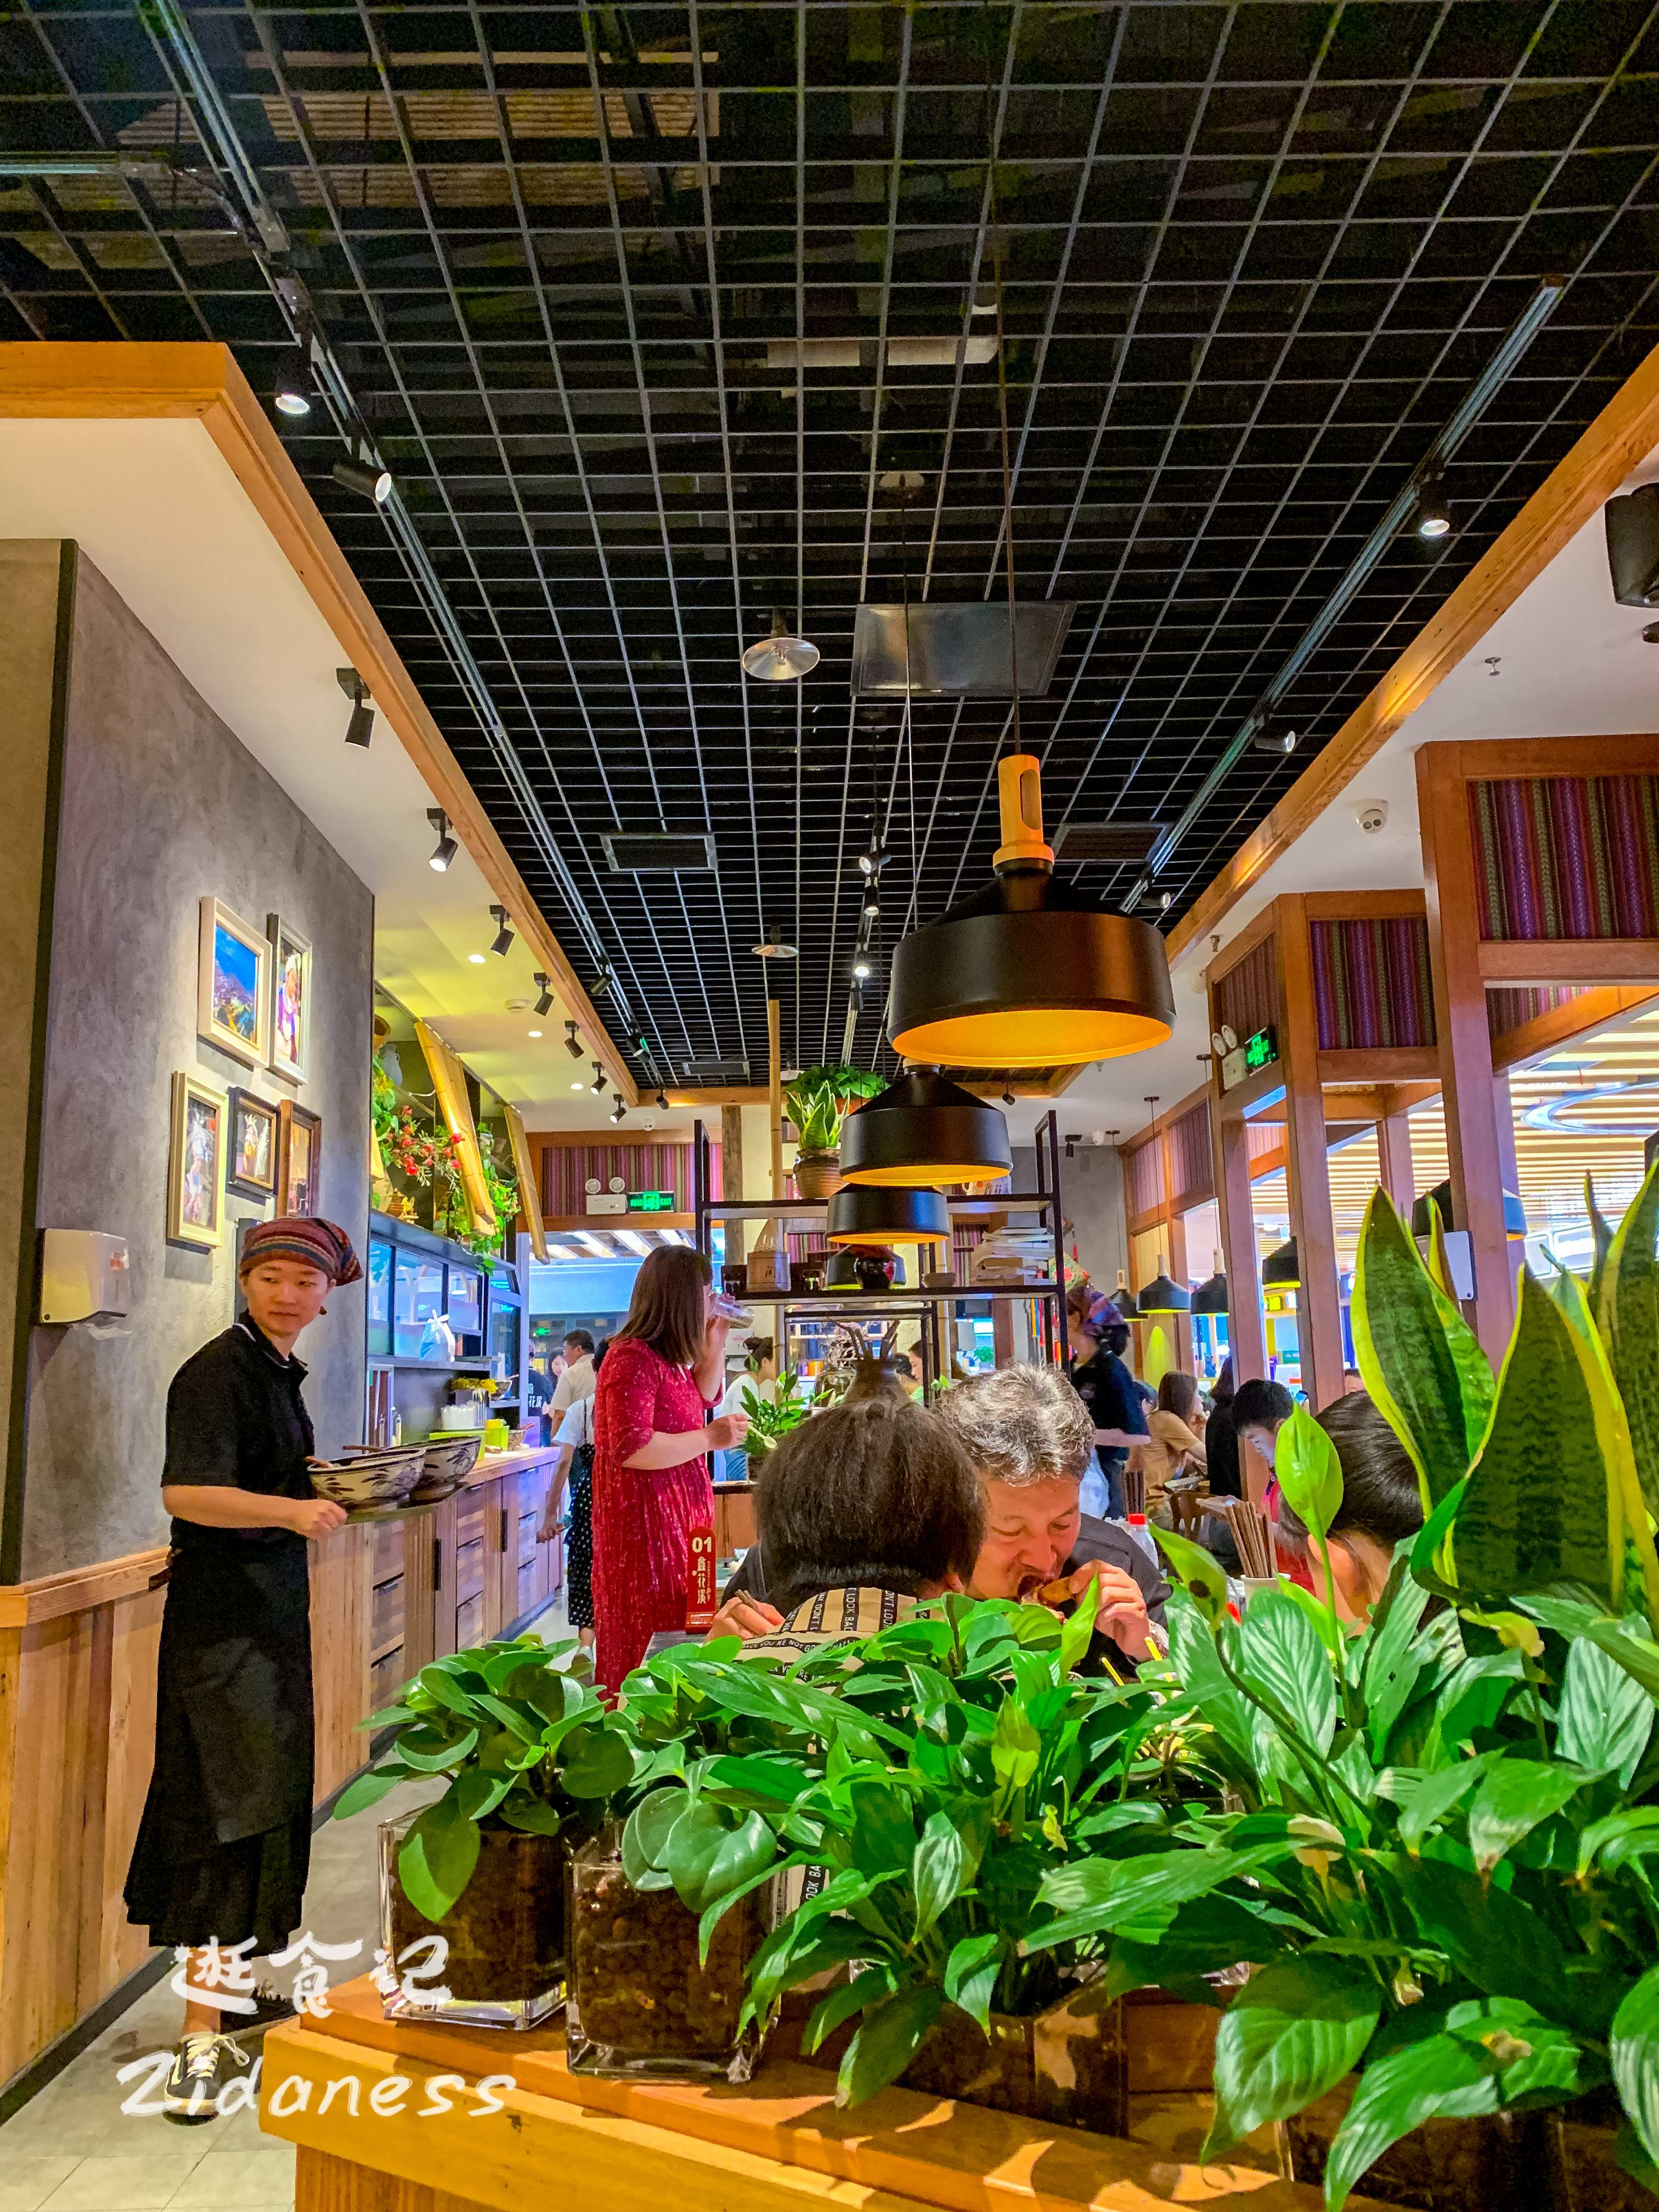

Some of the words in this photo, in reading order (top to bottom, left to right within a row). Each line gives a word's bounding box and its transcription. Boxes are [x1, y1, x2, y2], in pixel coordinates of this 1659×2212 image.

[692, 1537, 712, 1553] 01
[846, 1593, 856, 1613] LOOK
[844, 1617, 855, 1631] BAC
[805, 1880, 820, 1899] OOK
